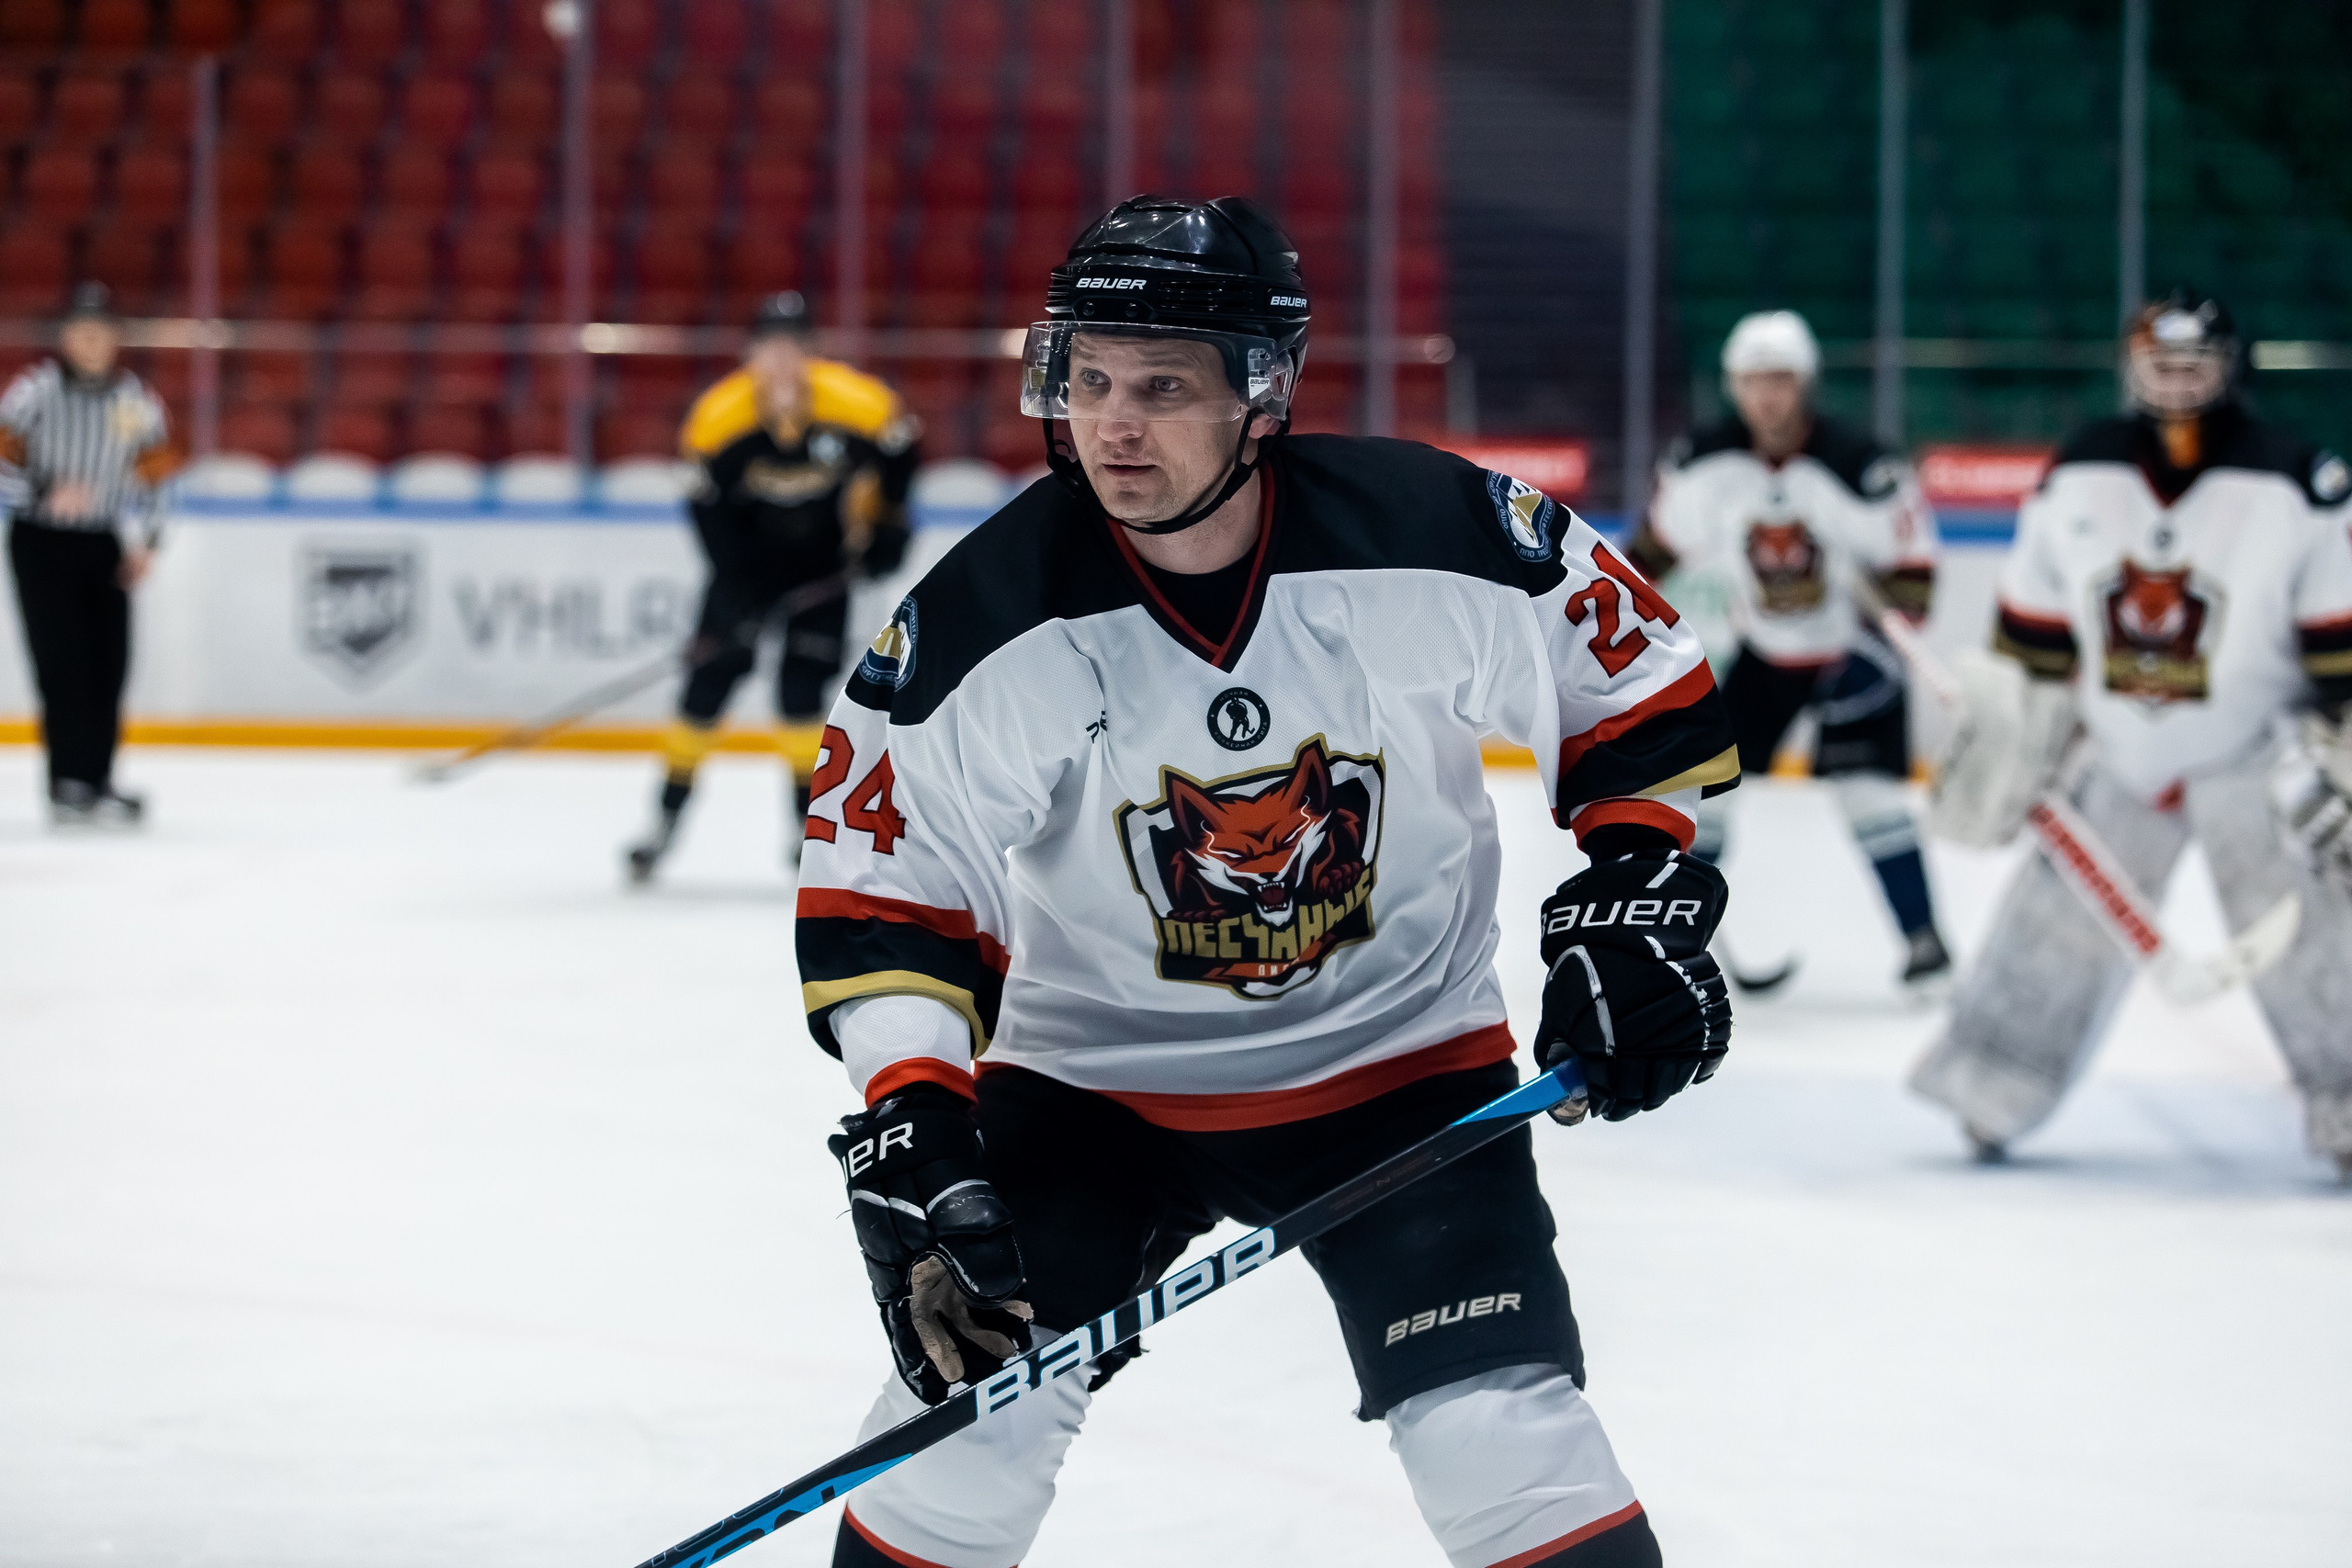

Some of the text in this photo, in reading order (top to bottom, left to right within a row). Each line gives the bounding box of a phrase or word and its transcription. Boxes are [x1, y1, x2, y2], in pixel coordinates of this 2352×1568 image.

[1076, 277, 1147, 290] BAUER
[1270, 296, 1307, 308] BAUER
[1564, 539, 1681, 679] 24
[803, 724, 907, 856] 24
[1385, 1292, 1521, 1348] BAUER
